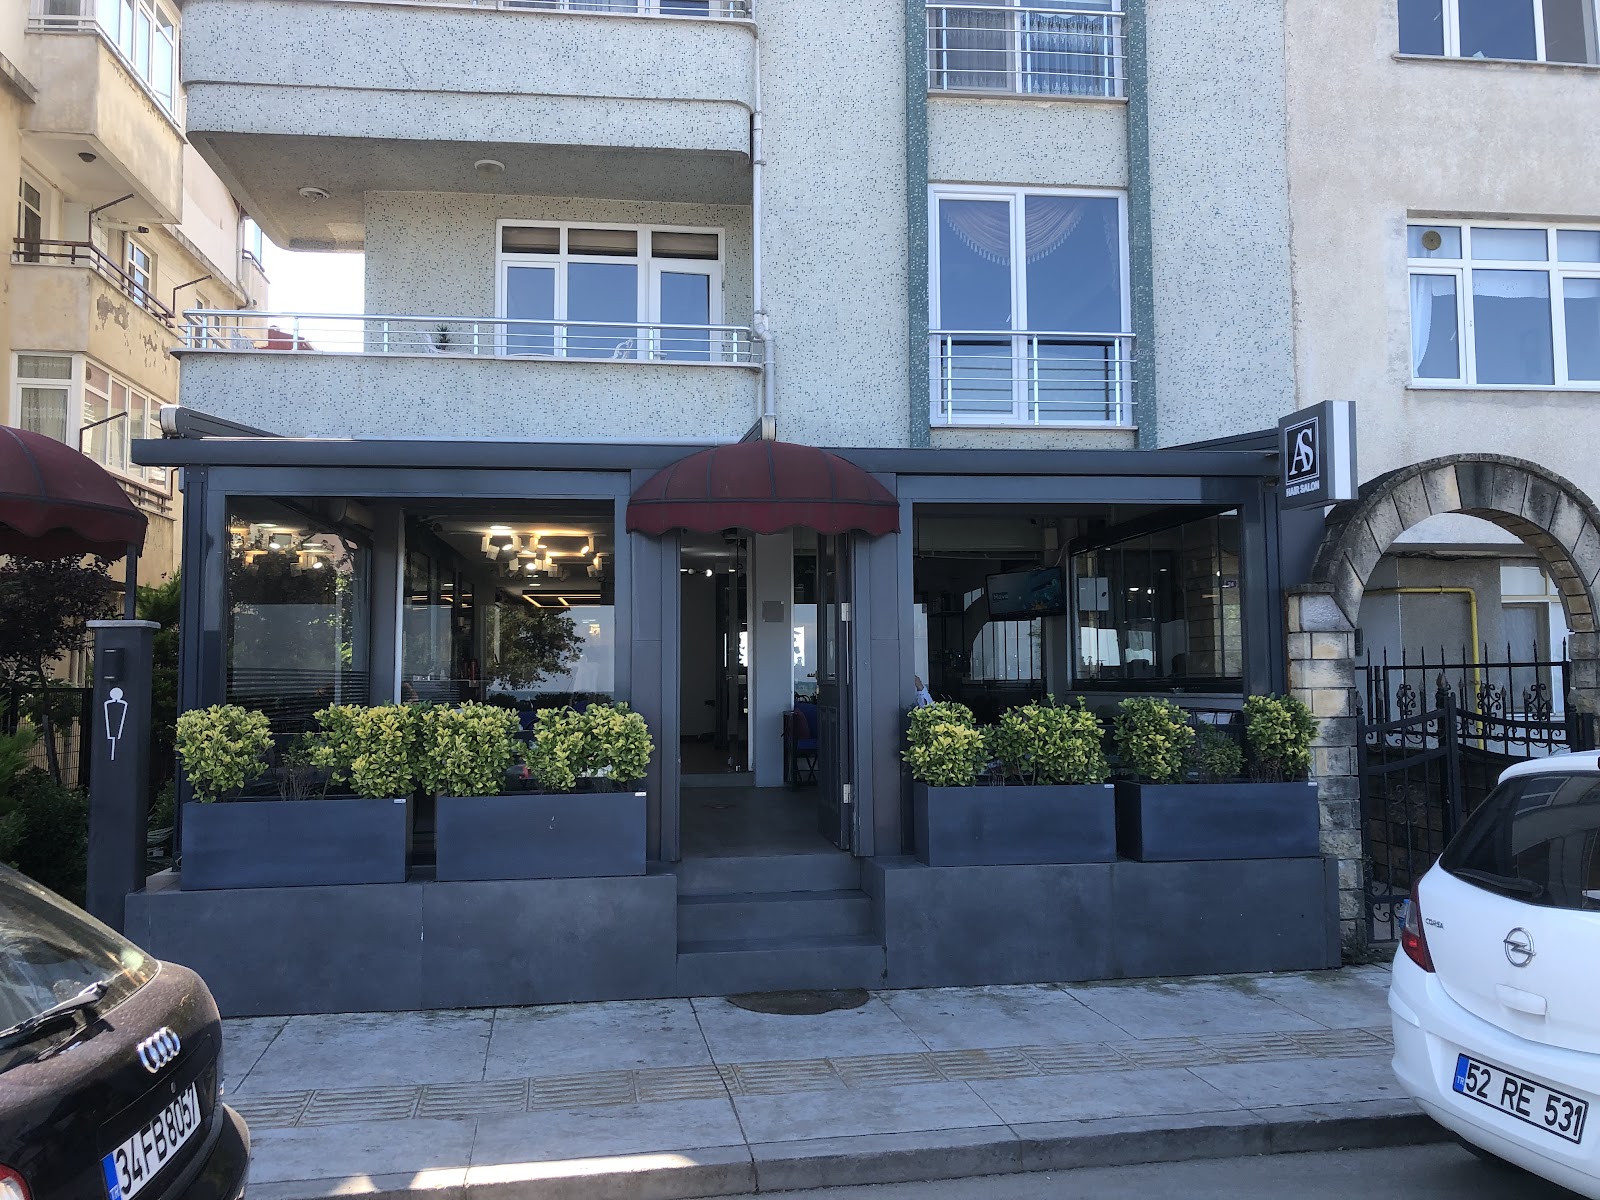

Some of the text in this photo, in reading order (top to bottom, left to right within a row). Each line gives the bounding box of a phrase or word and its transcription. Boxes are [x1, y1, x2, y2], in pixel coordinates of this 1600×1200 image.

[1289, 428, 1313, 475] AS
[1286, 480, 1319, 497] HAIR SALON
[1457, 1075, 1465, 1085] TR
[1466, 1062, 1583, 1136] 52 RE 531
